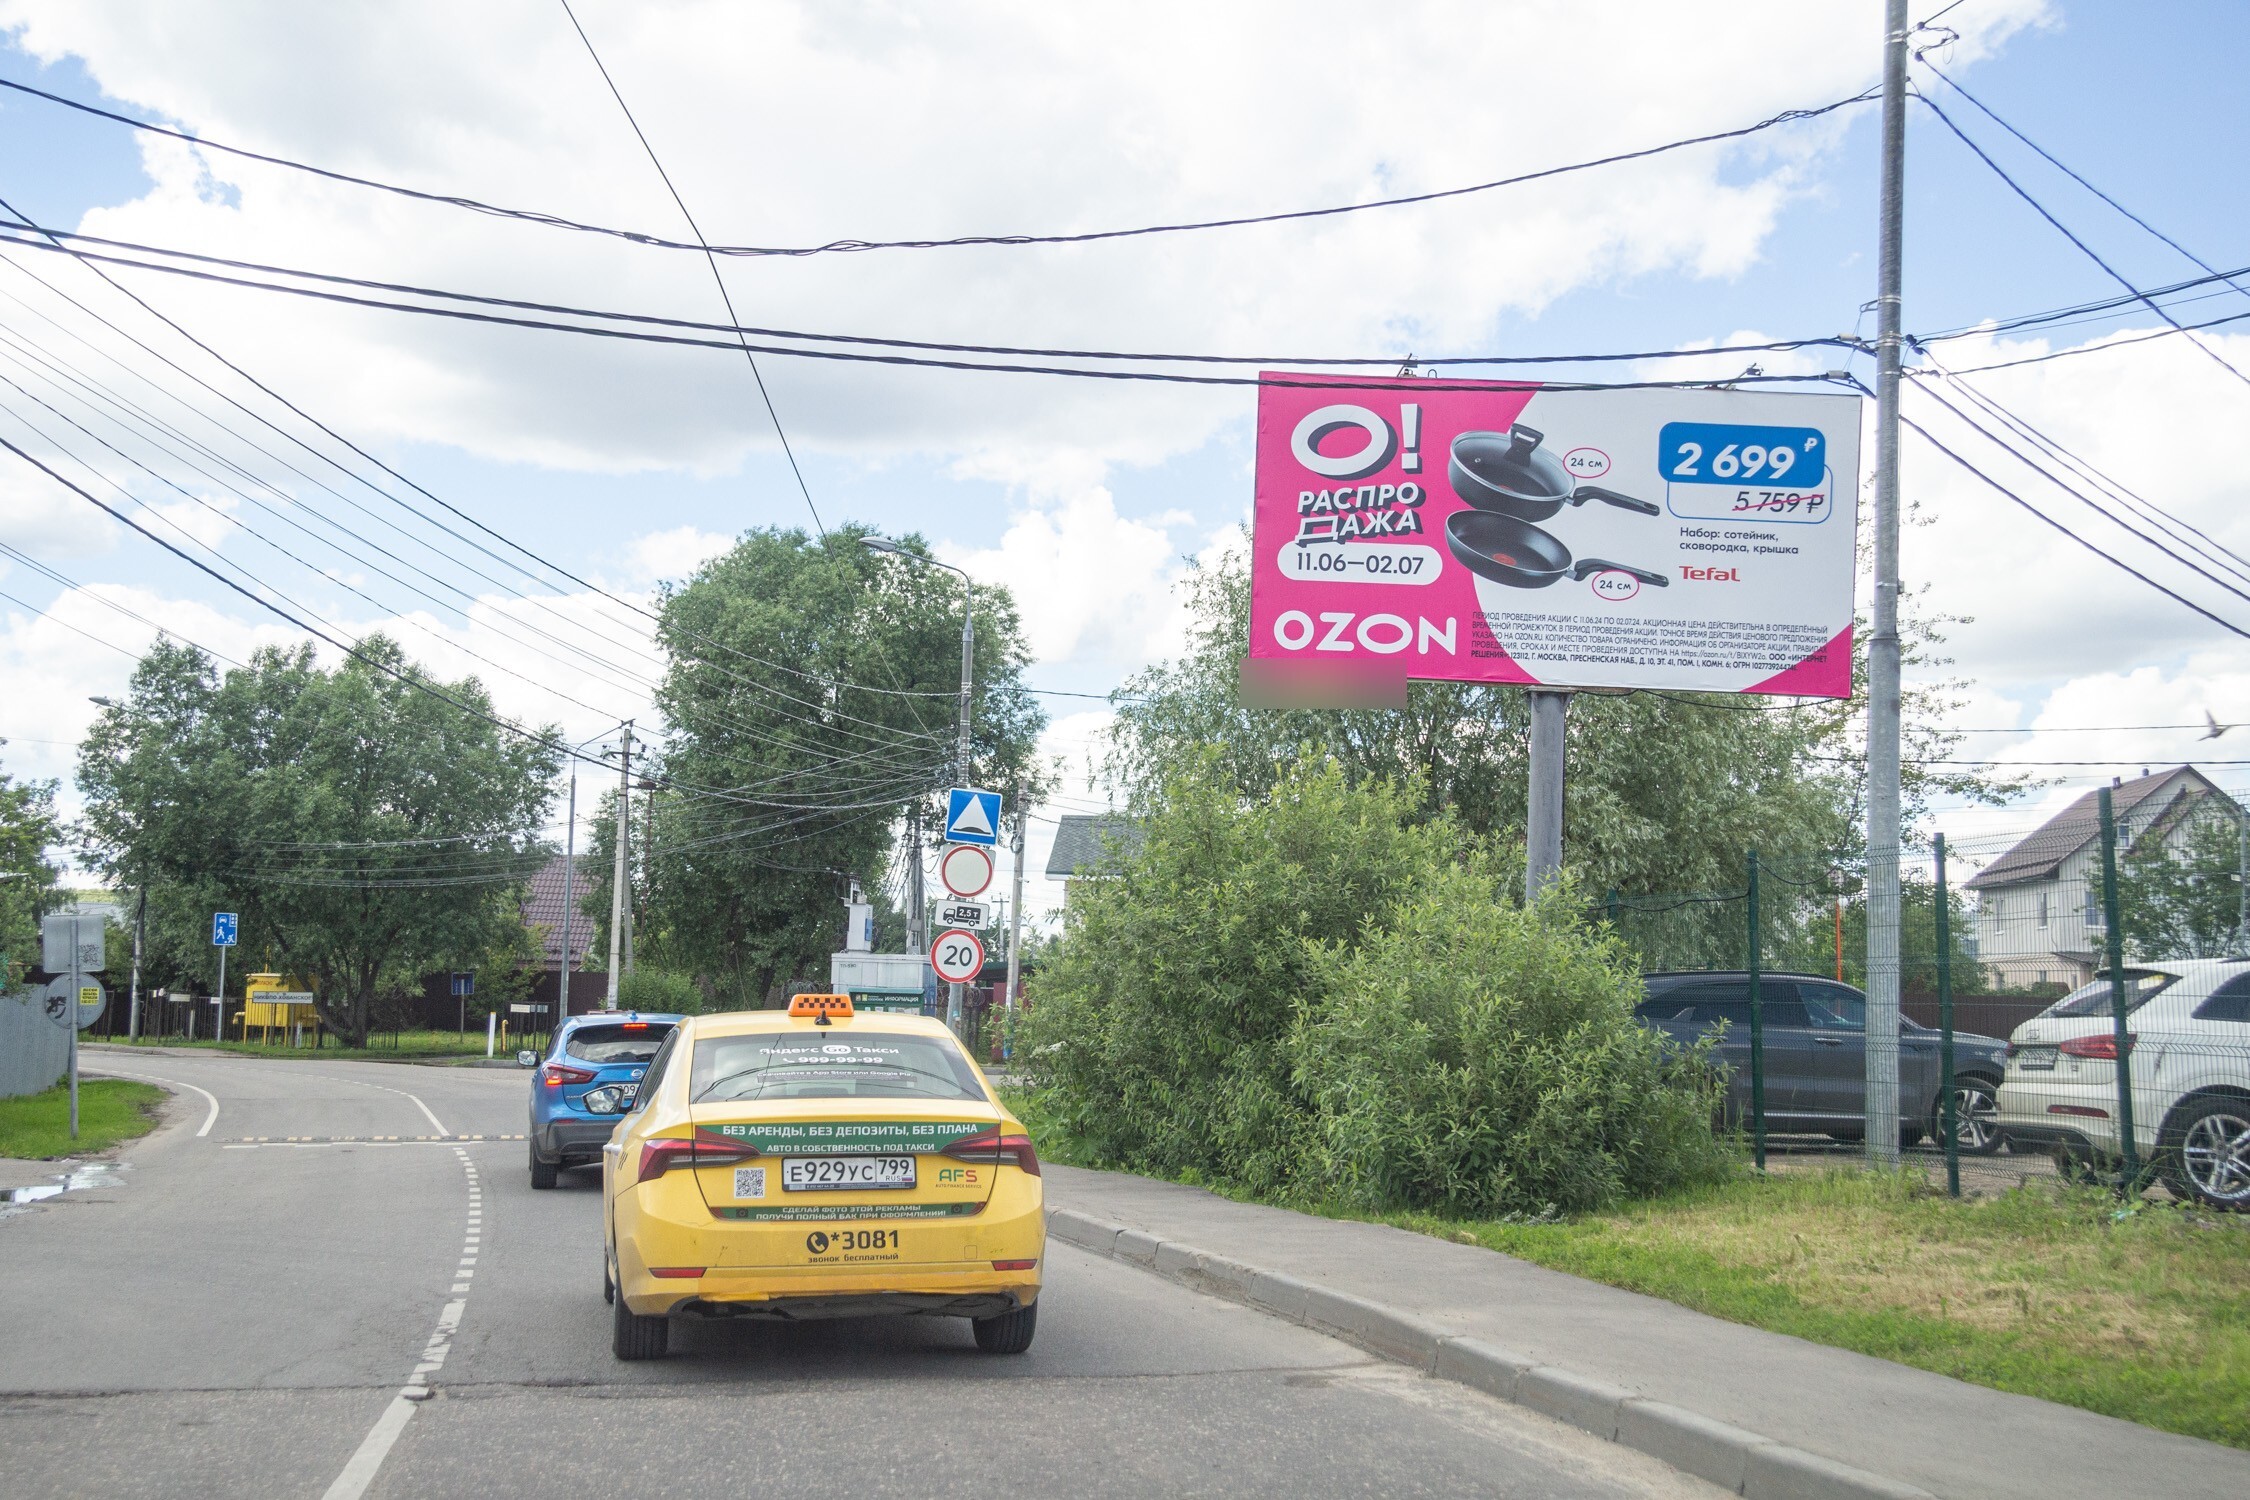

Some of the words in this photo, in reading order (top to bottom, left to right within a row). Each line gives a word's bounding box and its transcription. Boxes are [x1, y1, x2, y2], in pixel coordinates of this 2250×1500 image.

[1291, 403, 1421, 478] О!
[1570, 457, 1584, 467] 24
[1588, 460, 1602, 468] см
[1673, 442, 1702, 476] 2
[1712, 444, 1795, 479] 699
[1297, 482, 1423, 514] РАСПРО
[1734, 491, 1750, 511] 5
[1756, 492, 1800, 513] 759
[1294, 509, 1419, 545] ДАЖА
[1680, 527, 1720, 540] Набор:
[1724, 529, 1779, 542] сотейник,
[1679, 542, 1750, 554] сковородка,
[1753, 545, 1799, 555] крышка
[1679, 565, 1740, 582] Tefal
[1599, 579, 1613, 589] 24
[1617, 582, 1631, 590] см
[1473, 611, 1500, 621] ПЕРИОД
[1501, 612, 1546, 622] ПРОВЕДЕНИЯ
[1547, 614, 1572, 623] АКЦИИ
[1573, 615, 1578, 623] С
[1604, 617, 1615, 625] ПО
[1643, 619, 1687, 627] АКЦИОННАЯ
[1687, 620, 1706, 628] ЦЕНА
[1708, 621, 1764, 631] ДЕЙСТВИТЕЛЬНА
[1766, 624, 1771, 632] В
[1273, 610, 1457, 656] OZON
[1472, 620, 1511, 630] ВРЕМЕННОЙ
[1512, 623, 1557, 632] ПРОМЕЖУТОК
[1559, 624, 1564, 632] В
[1564, 624, 1591, 634] ПЕРИОД
[1592, 626, 1633, 635] ПРОВЕДЕНИЯ
[1660, 629, 1685, 638] ТОЧНОЕ
[1686, 630, 1708, 638] ВРЕМЯ
[1708, 630, 1741, 640] ДЕЙСТВИЯ
[1742, 632, 1778, 642] ЦЕНОВОГО
[1779, 634, 1828, 644] ПРЕДЛОЖЕНИЯ
[1472, 631, 1503, 639] УКАЗАНО
[1504, 632, 1513, 640] НА
[1545, 633, 1588, 643] КОЛИЧЕСТВО
[1589, 635, 1614, 644] ТОВАРА
[1660, 639, 1707, 648] ИНФОРМАЦИЯ
[1707, 640, 1718, 648] ОБ
[1719, 641, 1766, 650] ОРГАНИЗАТОРЕ
[1520, 642, 1549, 651] СРОКАХ
[1557, 644, 1580, 652] МЕСТЕ
[1582, 645, 1628, 654] ПРОВЕДЕНИЯ
[1629, 647, 1668, 656] ДОСТУПНА
[1537, 653, 1569, 662] МОСКВА,
[1570, 654, 1620, 663] ПРЕСНЕНСКАЯ
[1677, 658, 1695, 667] ПОМ.
[1701, 660, 1724, 669] КОМН.
[1733, 661, 1750, 669] ОГРН
[958, 908, 972, 917] 2,5
[943, 945, 973, 967] 20
[884, 995, 919, 1003] ИНФОРМАЦИЯ
[759, 1047, 819, 1055] Яндекс
[852, 1046, 900, 1054] Такси
[797, 1056, 884, 1064] 999-99-99
[723, 1125, 746, 1135] БЕЗ
[749, 1126, 807, 1138] АРЕНДЫ,
[809, 1126, 833, 1136] БЕЗ
[835, 1126, 910, 1138] ДЕПОЗИТЫ,
[912, 1124, 935, 1135] БЕЗ
[938, 1123, 978, 1134] ПЛАНА
[766, 1144, 792, 1152] АВТО
[794, 1144, 800, 1152] В
[801, 1144, 881, 1152] СОБСТВЕННОСТЬ
[883, 1144, 904, 1152] ПОД
[905, 1143, 935, 1151] ТАКСИ
[878, 1159, 910, 1175] 799
[939, 1168, 978, 1182] AFS
[782, 1205, 819, 1213] СДЕЛАЙ
[849, 1205, 874, 1213] ЭТОЙ
[875, 1204, 921, 1212] РЕКЛАМЫ
[795, 1212, 836, 1220] ПОЛНЫЙ
[859, 1211, 878, 1219] ПРИ
[880, 1210, 946, 1218] ОФОРМЛЕНИИ!
[807, 1256, 840, 1264] звонок
[843, 1253, 899, 1263] бесплатный
